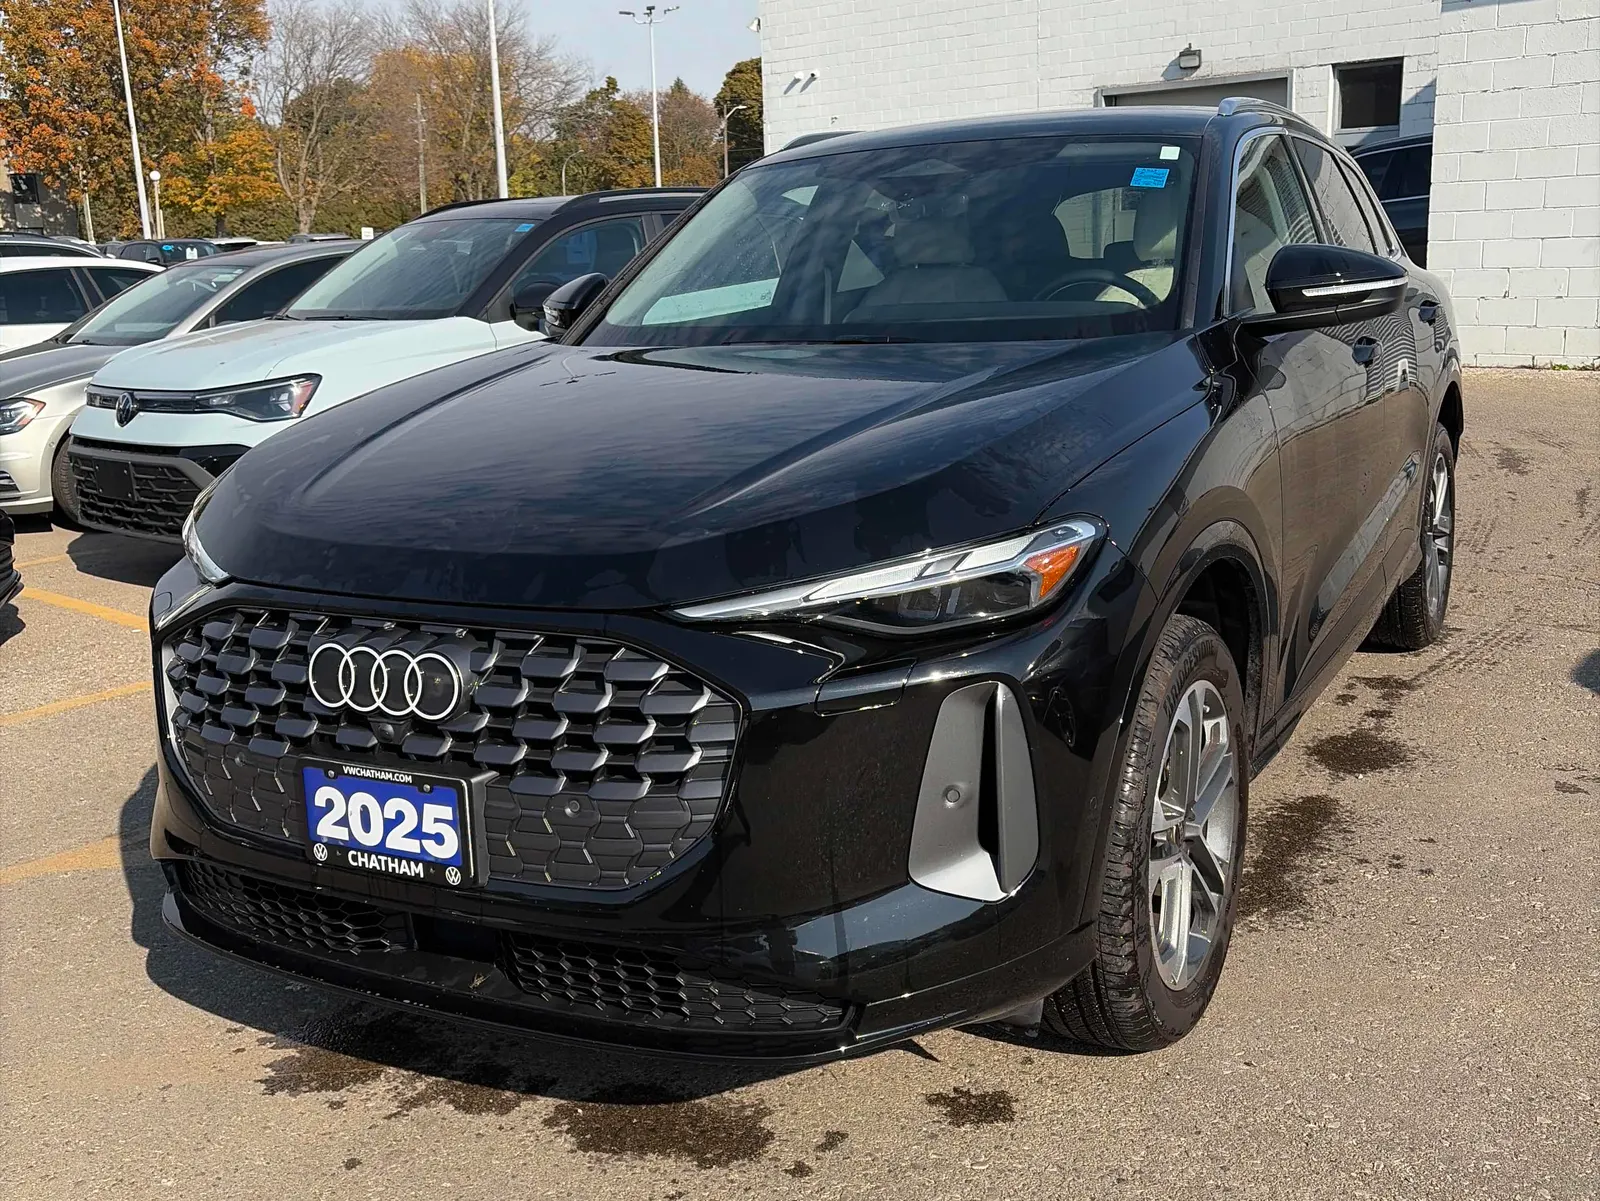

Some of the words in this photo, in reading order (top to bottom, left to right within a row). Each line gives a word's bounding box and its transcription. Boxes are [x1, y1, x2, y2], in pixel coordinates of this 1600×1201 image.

[342, 765, 413, 784] VWCHATHAM.COM
[314, 785, 459, 859] 2025
[347, 850, 424, 878] CHATHAM
